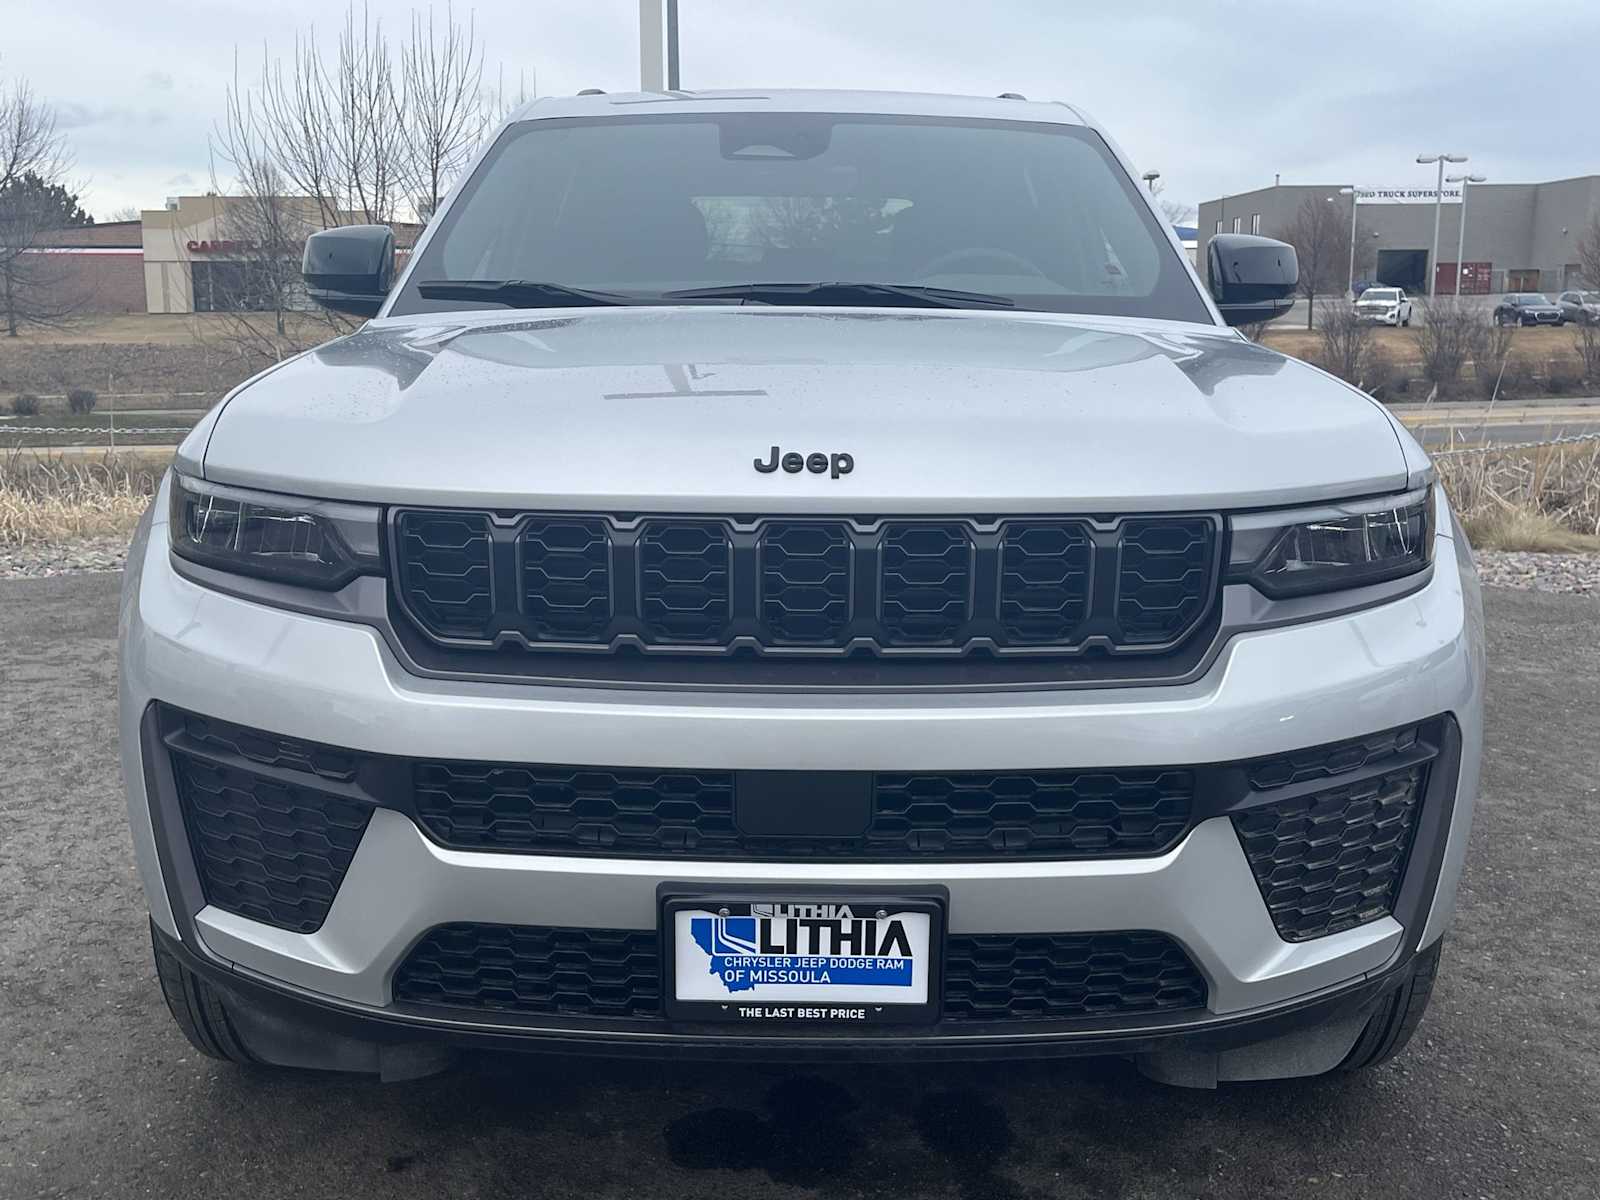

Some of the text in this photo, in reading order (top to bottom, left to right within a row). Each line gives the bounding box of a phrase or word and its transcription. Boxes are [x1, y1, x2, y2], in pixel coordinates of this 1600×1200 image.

[1377, 190, 1406, 198] TRUCK
[753, 446, 854, 480] Jeep
[774, 904, 856, 919] LITHIA
[760, 919, 913, 956] LITHIA
[724, 957, 904, 970] CHRYSLER JEEP DODGE RAM
[724, 970, 831, 983] OF MISSOULA
[739, 1007, 865, 1019] THE LAST BEST PRICE
